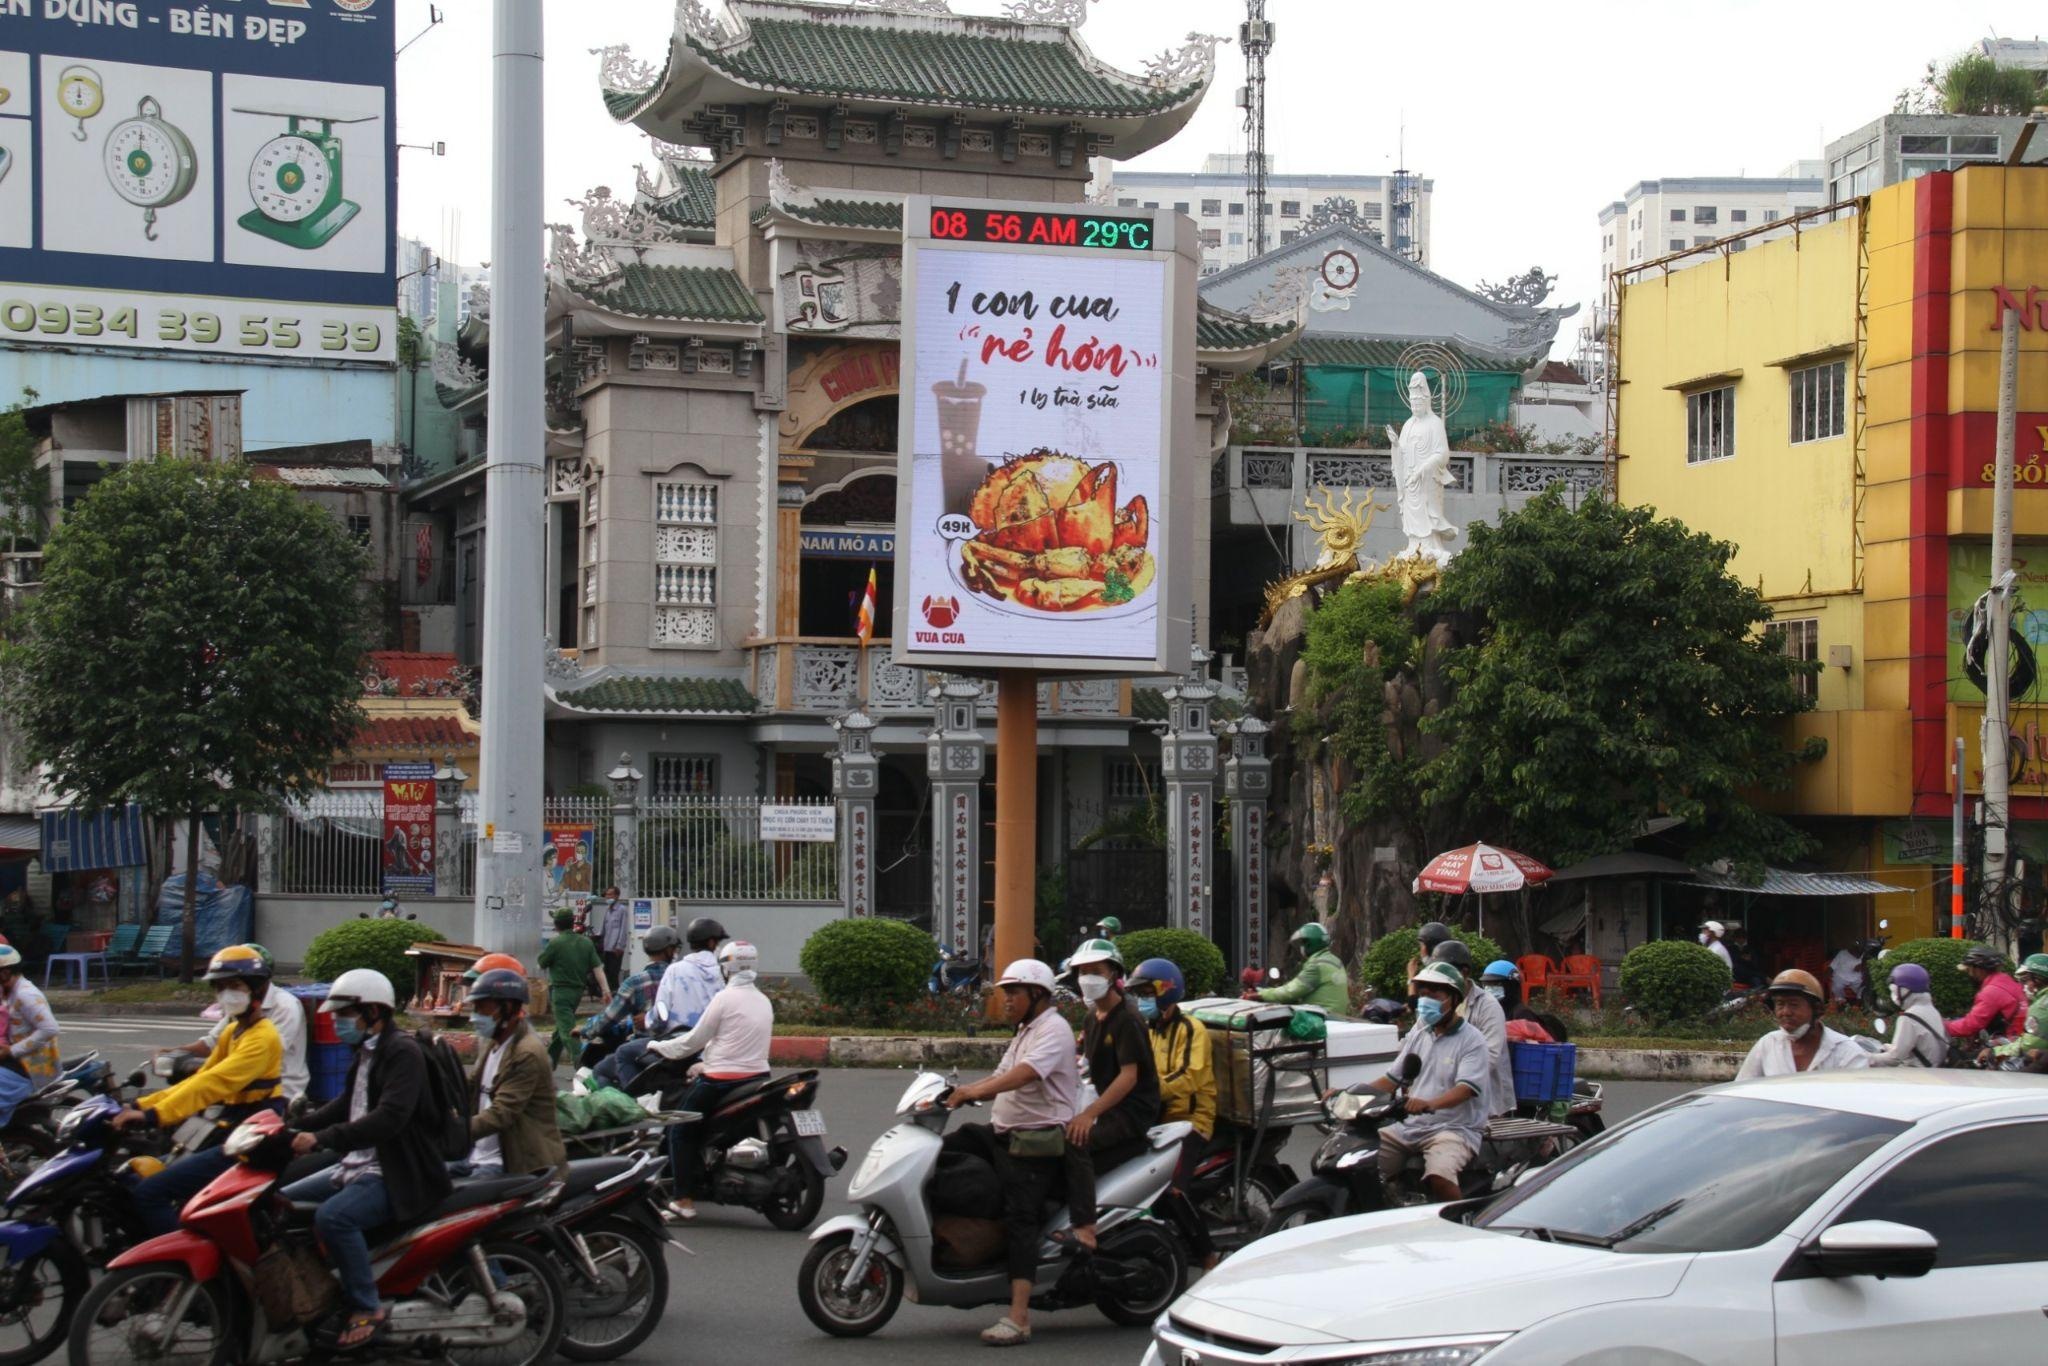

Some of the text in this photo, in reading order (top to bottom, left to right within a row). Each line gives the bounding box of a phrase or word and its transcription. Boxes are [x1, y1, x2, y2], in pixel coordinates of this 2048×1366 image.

[45, 0, 139, 29] DỤNG
[170, 4, 235, 39] BỀN
[245, 15, 307, 48] ĐẸP
[931, 210, 968, 239] 08
[985, 214, 1022, 241] 56
[1028, 217, 1077, 245] AM
[946, 280, 1119, 322] 1 con cua
[1, 300, 381, 353] 0934 39 55 39
[820, 354, 879, 403] CHÙA
[1020, 385, 1119, 410] 1 ly trà sữa
[800, 536, 834, 550] NAM
[838, 535, 865, 551] MÔ
[867, 538, 879, 552] A
[915, 631, 965, 644] VUA CUA
[1435, 868, 1460, 877] TÍNH
